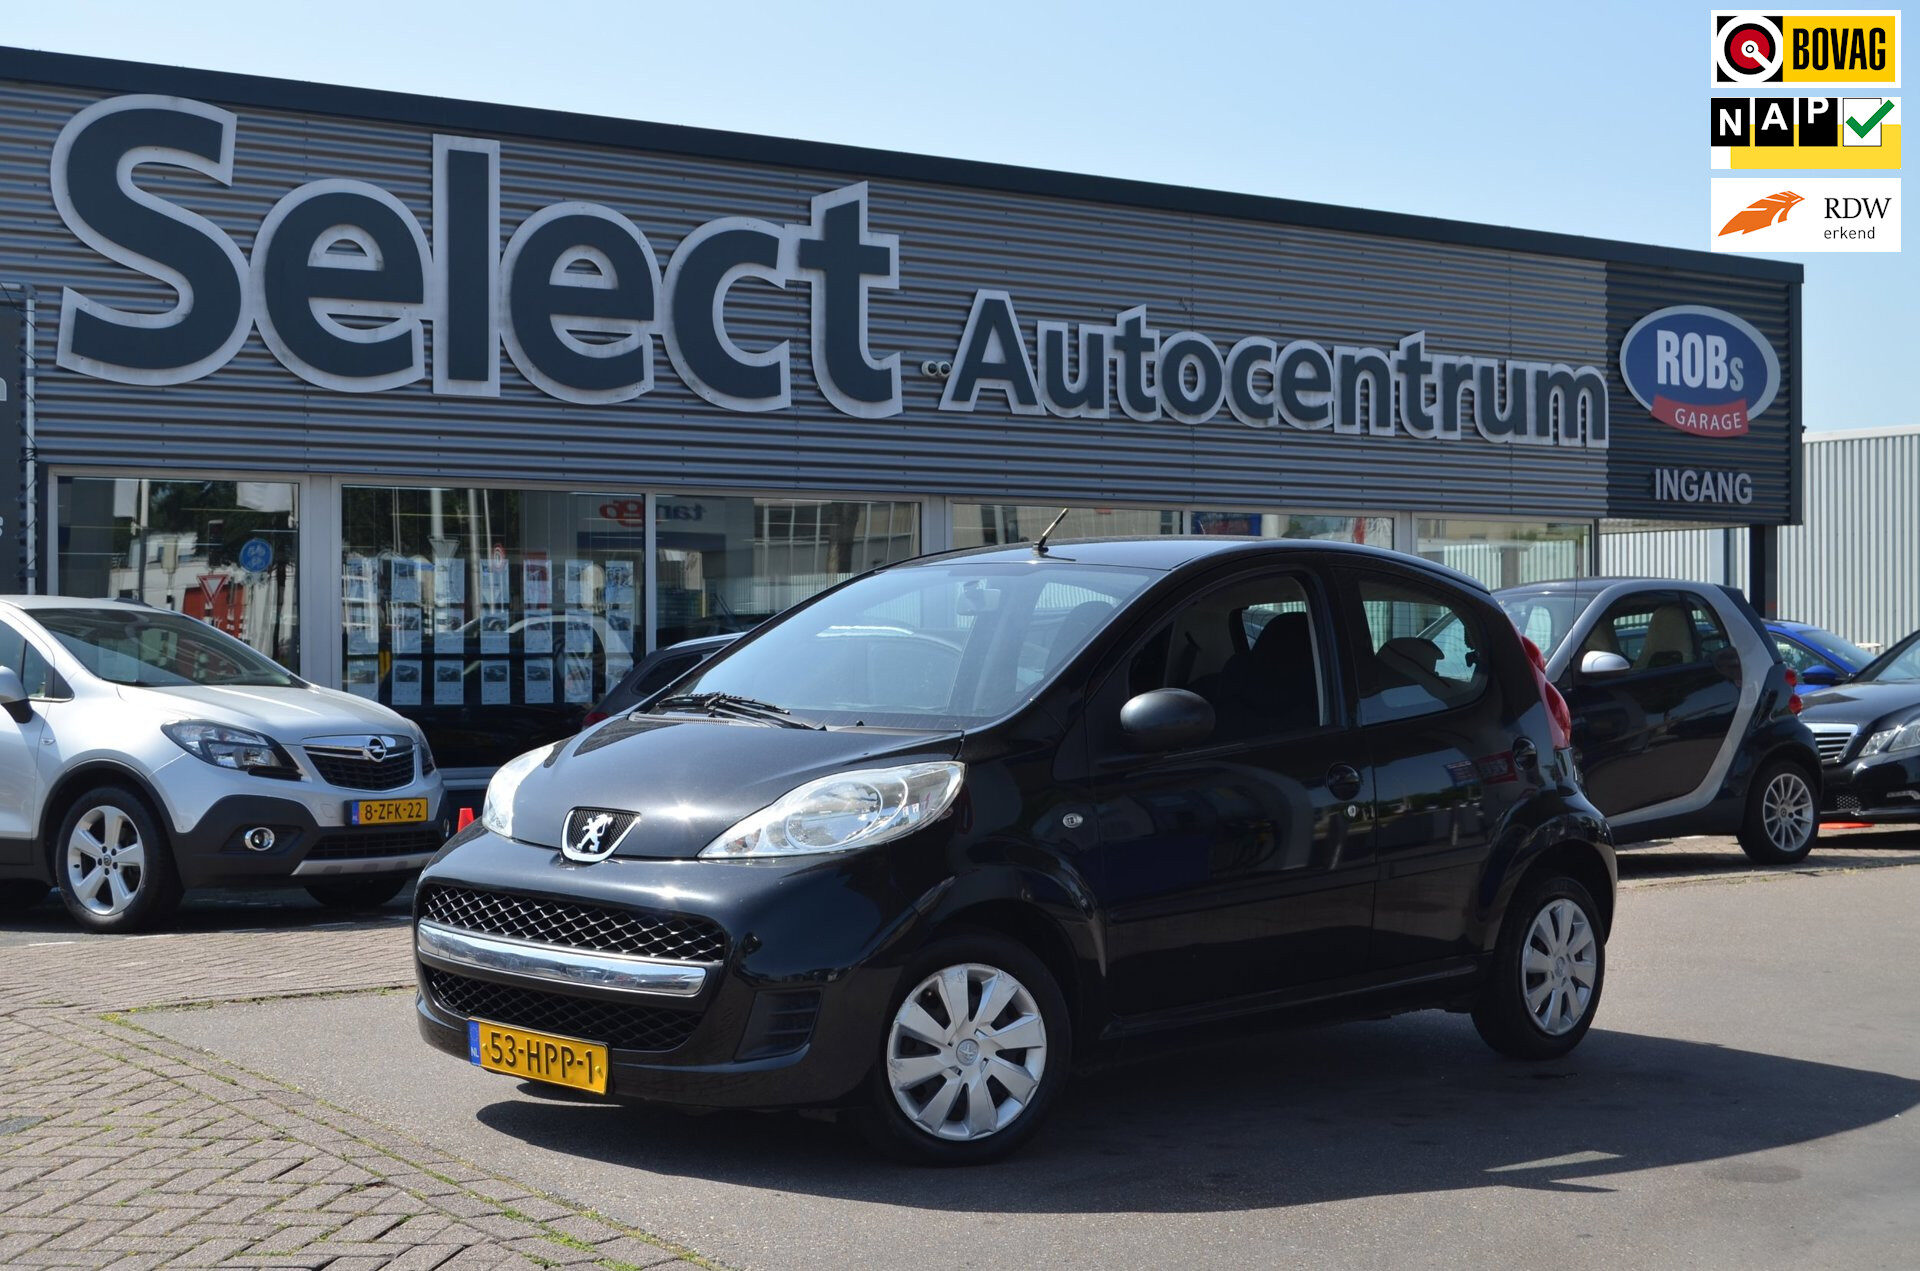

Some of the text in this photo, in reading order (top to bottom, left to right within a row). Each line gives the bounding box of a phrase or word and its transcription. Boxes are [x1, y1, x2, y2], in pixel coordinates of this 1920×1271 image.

[50, 94, 1609, 449] Select Autocentrum
[1656, 329, 1745, 392] ROBs
[1674, 408, 1743, 431] GARAGE
[1655, 468, 1753, 505] INGANG
[364, 801, 422, 821] 8-ZFK-22
[490, 1031, 594, 1085] 53-HPP-1
